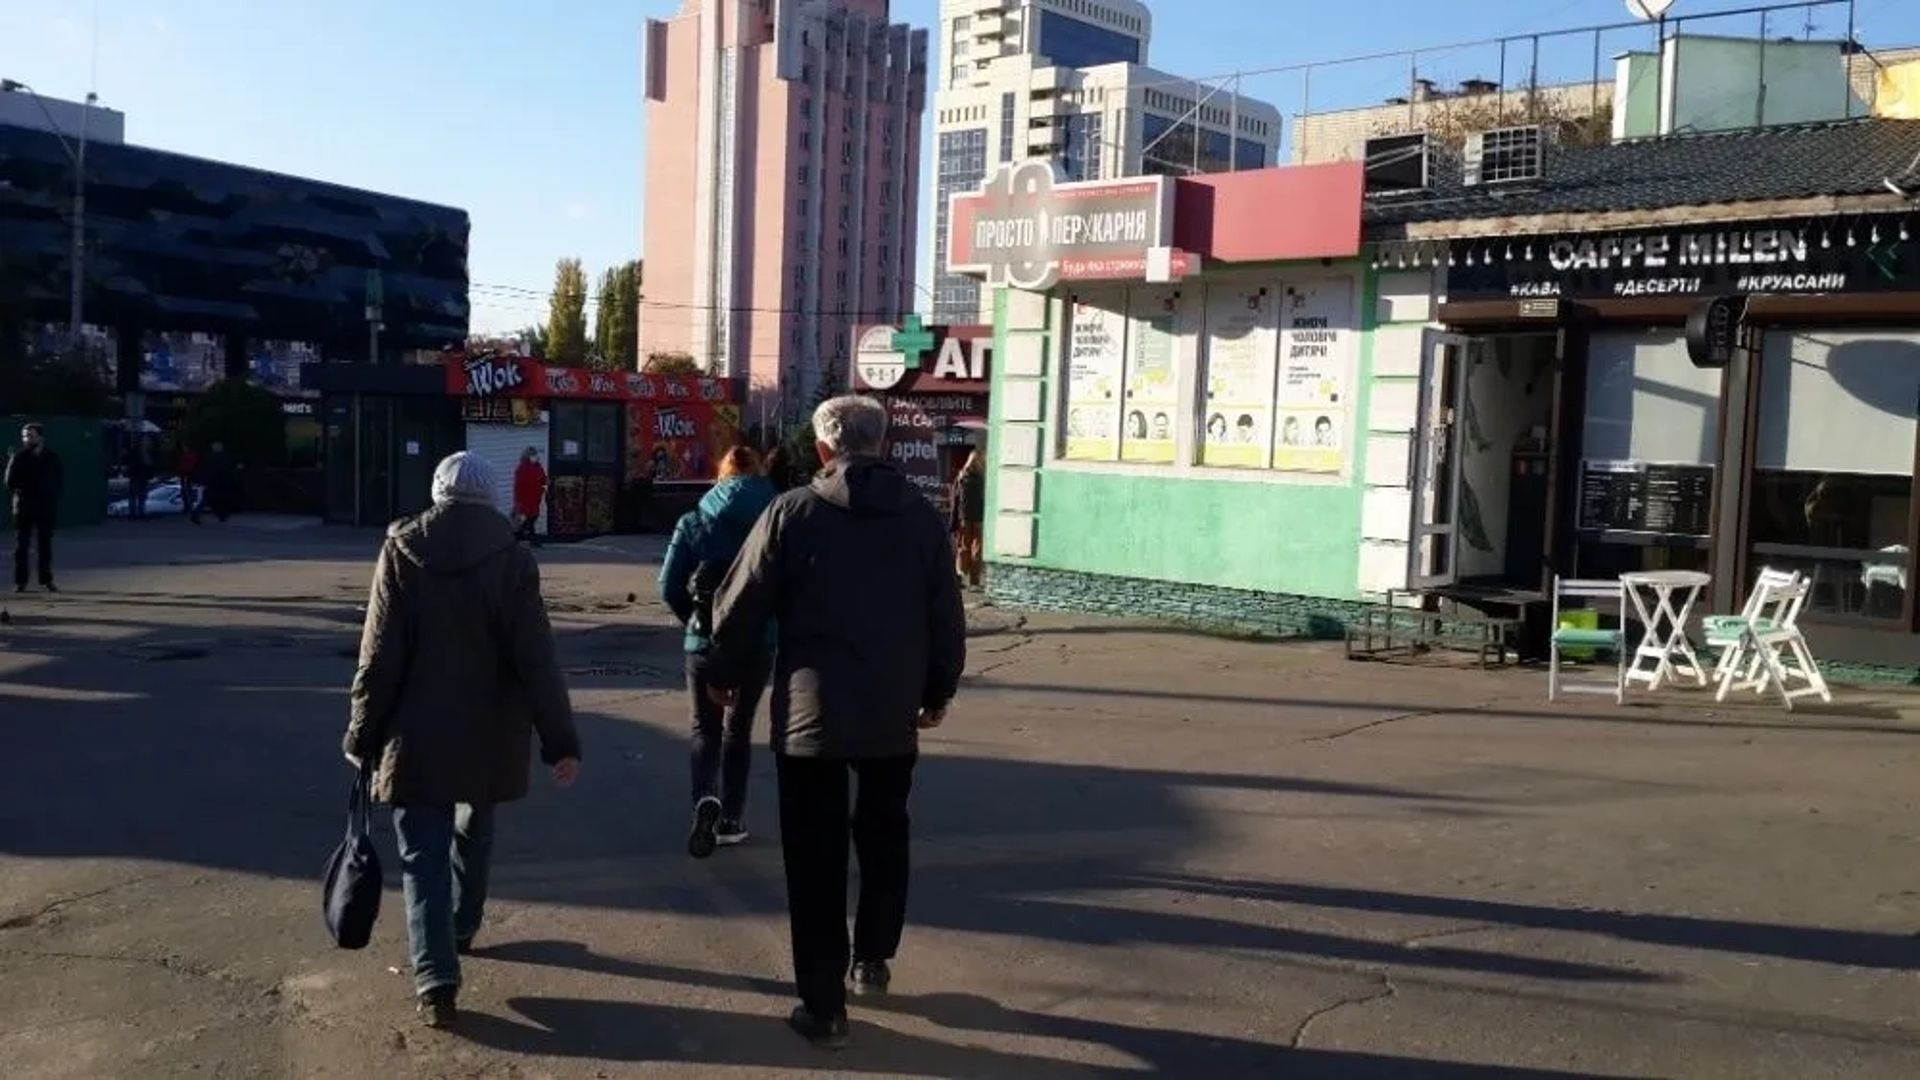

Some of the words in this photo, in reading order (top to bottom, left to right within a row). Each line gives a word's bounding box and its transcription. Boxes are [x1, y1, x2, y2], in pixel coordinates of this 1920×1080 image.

[976, 217, 1034, 249] ПРОСТО
[1052, 209, 1147, 245] ПЕРУКАРНЯ
[1549, 235, 1666, 270] CAFFE
[1679, 230, 1807, 265] MILEN
[1510, 281, 1561, 296] #КАВА
[1613, 277, 1701, 296] #ДЕСЕРТИ
[1737, 273, 1845, 290] #КРУАСАНИ
[892, 414, 909, 427] НА
